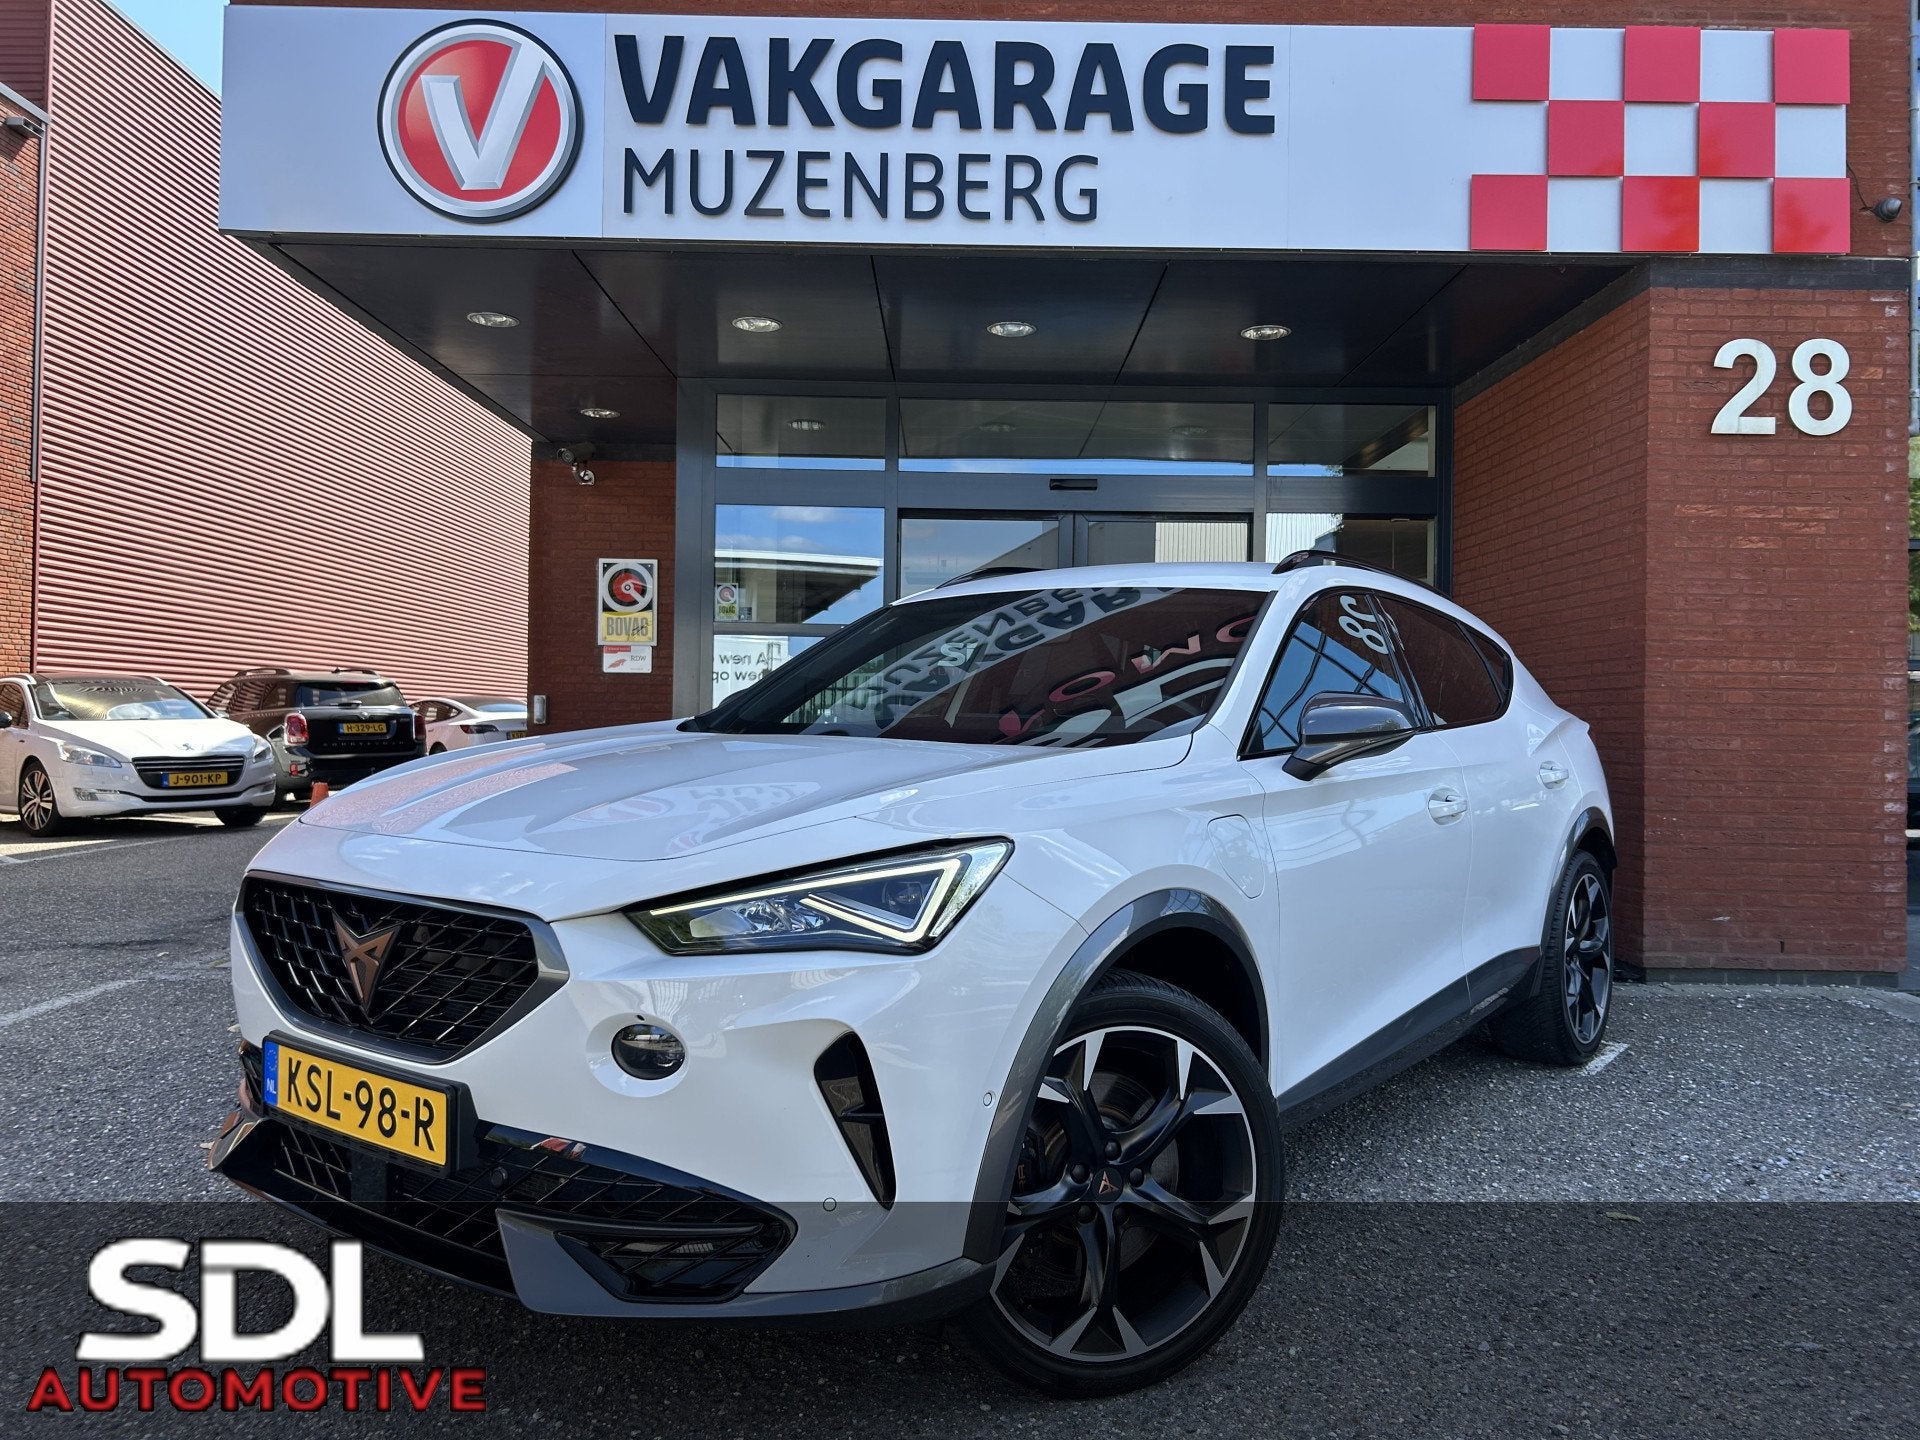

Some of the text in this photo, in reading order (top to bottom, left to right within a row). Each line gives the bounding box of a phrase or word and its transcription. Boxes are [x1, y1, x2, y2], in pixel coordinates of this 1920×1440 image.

[613, 34, 1276, 135] VAKGARAGE
[622, 148, 1100, 222] MUZENBERG
[1710, 338, 1853, 437] 28
[346, 725, 384, 733] H-329-LG
[173, 774, 221, 785] J-901-KP
[287, 1056, 435, 1152] KSL-98-R
